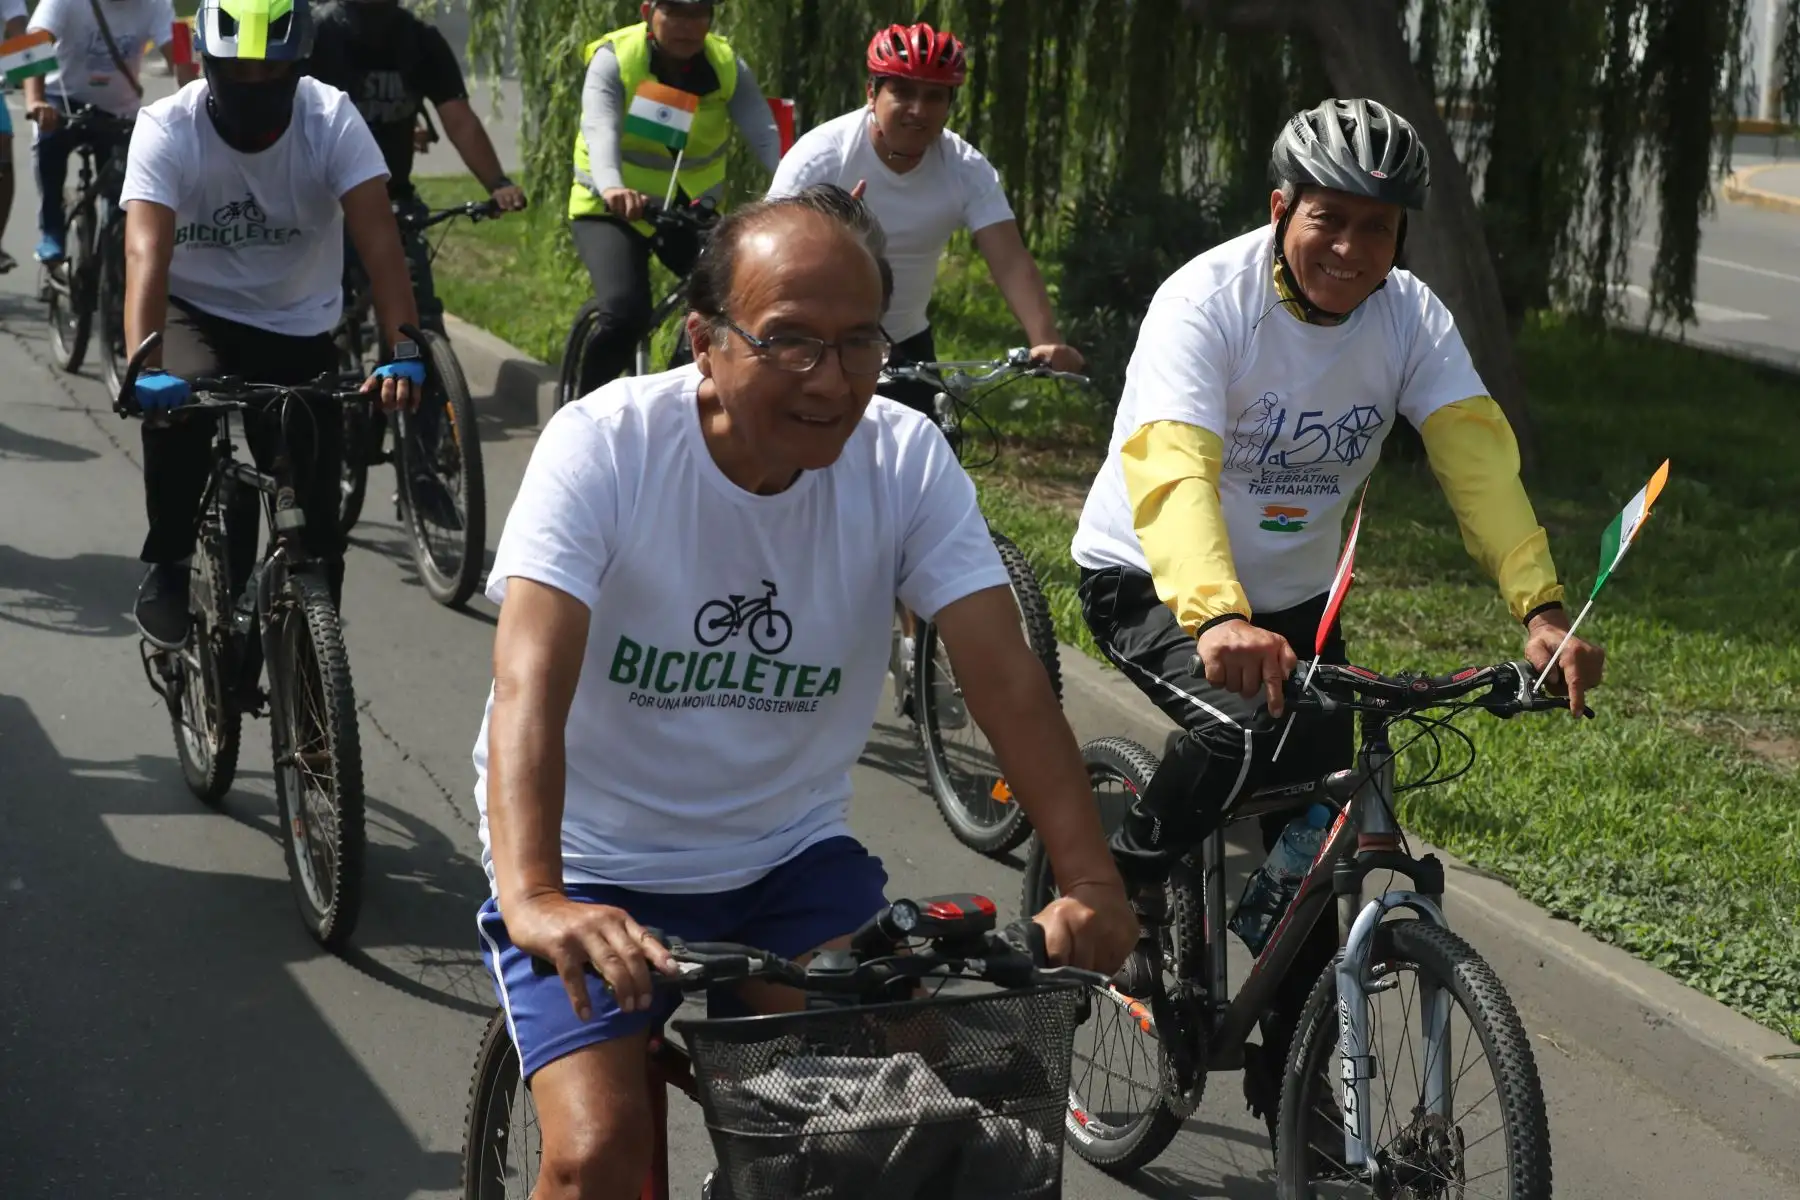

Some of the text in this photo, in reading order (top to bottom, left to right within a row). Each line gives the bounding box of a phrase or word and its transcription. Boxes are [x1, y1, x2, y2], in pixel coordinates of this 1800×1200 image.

[1248, 483, 1341, 495] THE MAHATMA
[608, 634, 842, 698] BICICLETEA
[628, 692, 819, 713] POR UNA MOVILIDAD SOSTENIBLE
